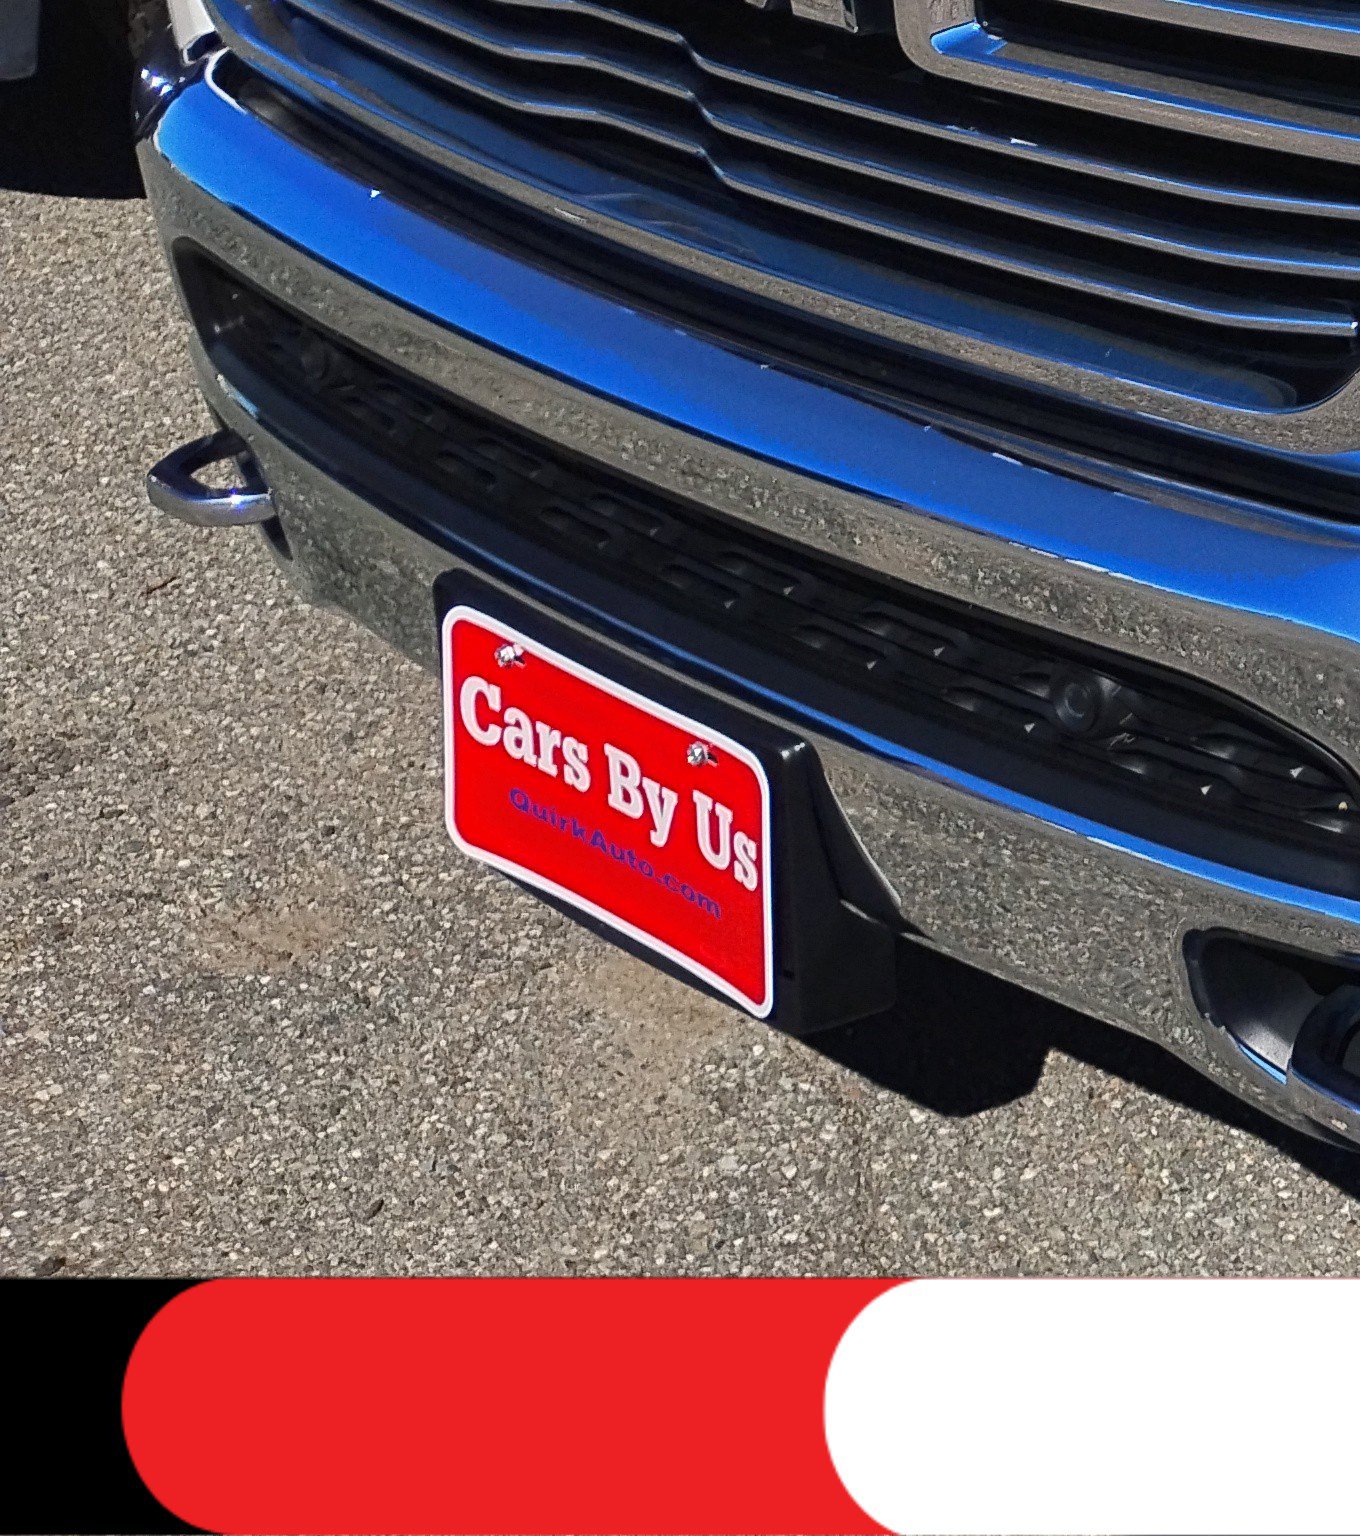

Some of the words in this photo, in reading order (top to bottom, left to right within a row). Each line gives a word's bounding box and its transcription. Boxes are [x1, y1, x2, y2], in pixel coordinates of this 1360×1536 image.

[459, 675, 591, 793] Cars
[604, 743, 678, 848] By
[693, 790, 759, 892] Us
[508, 788, 722, 920] QuirkAuto.com
